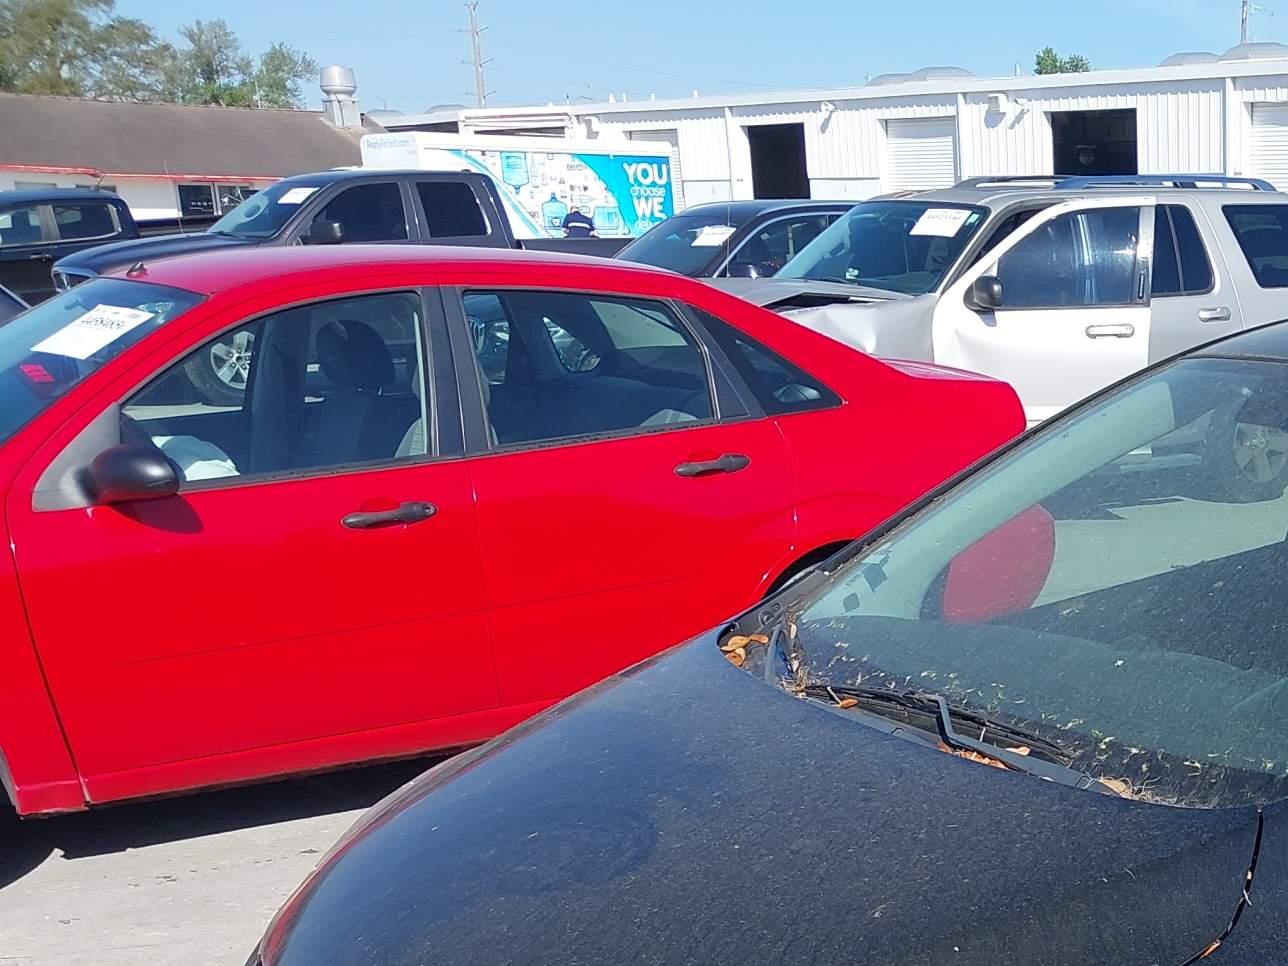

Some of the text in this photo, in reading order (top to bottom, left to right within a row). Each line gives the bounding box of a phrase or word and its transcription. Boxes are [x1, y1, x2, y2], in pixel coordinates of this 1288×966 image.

[623, 162, 667, 185] YOU
[629, 186, 666, 197] choose
[633, 198, 667, 219] WE
